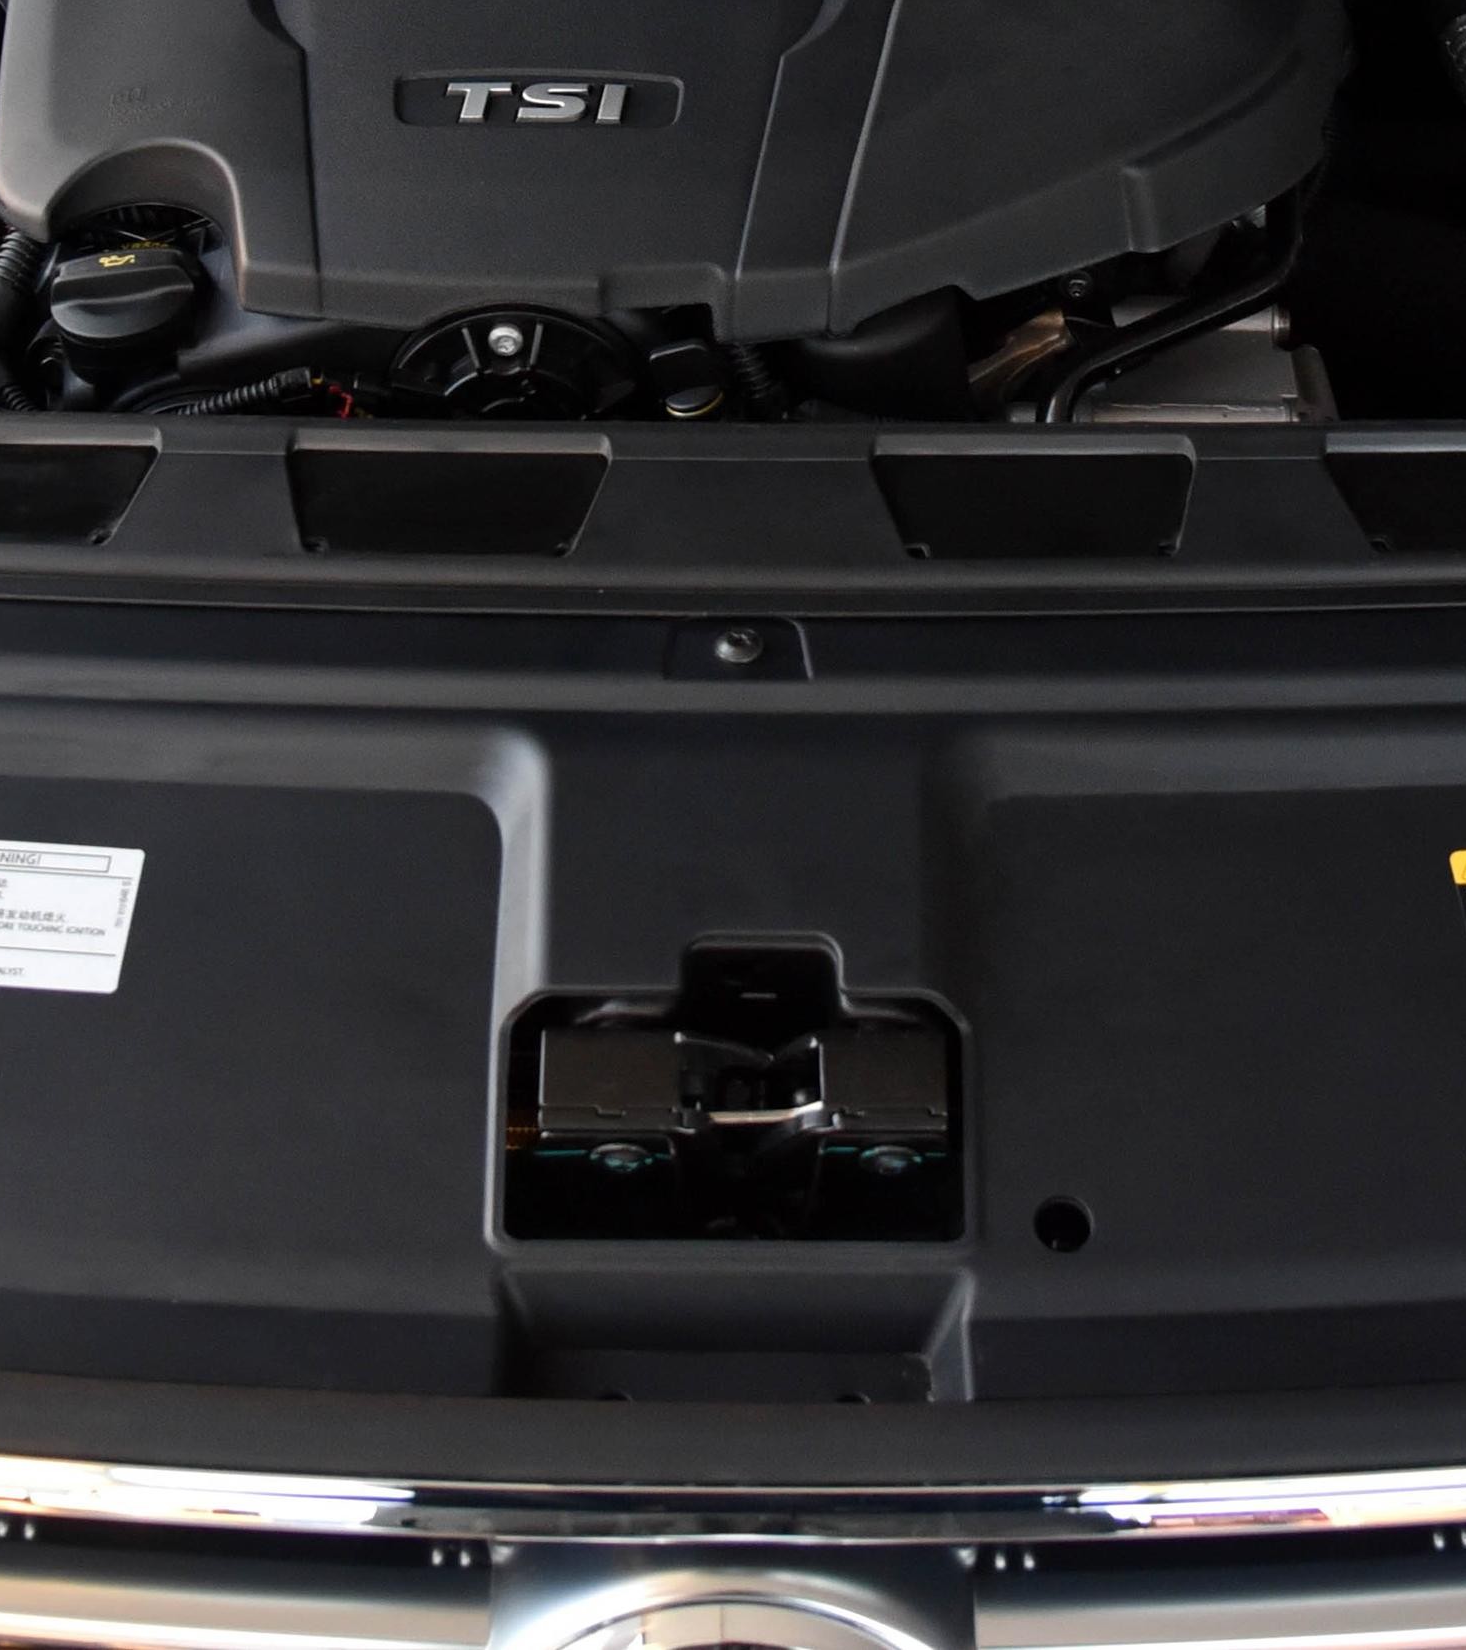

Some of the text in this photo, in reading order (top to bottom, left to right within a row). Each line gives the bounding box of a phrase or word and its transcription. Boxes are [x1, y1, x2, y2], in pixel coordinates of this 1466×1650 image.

[445, 81, 630, 125] TSI
[17, 921, 64, 933] TOUCHING
[65, 925, 106, 936] IGNITION
